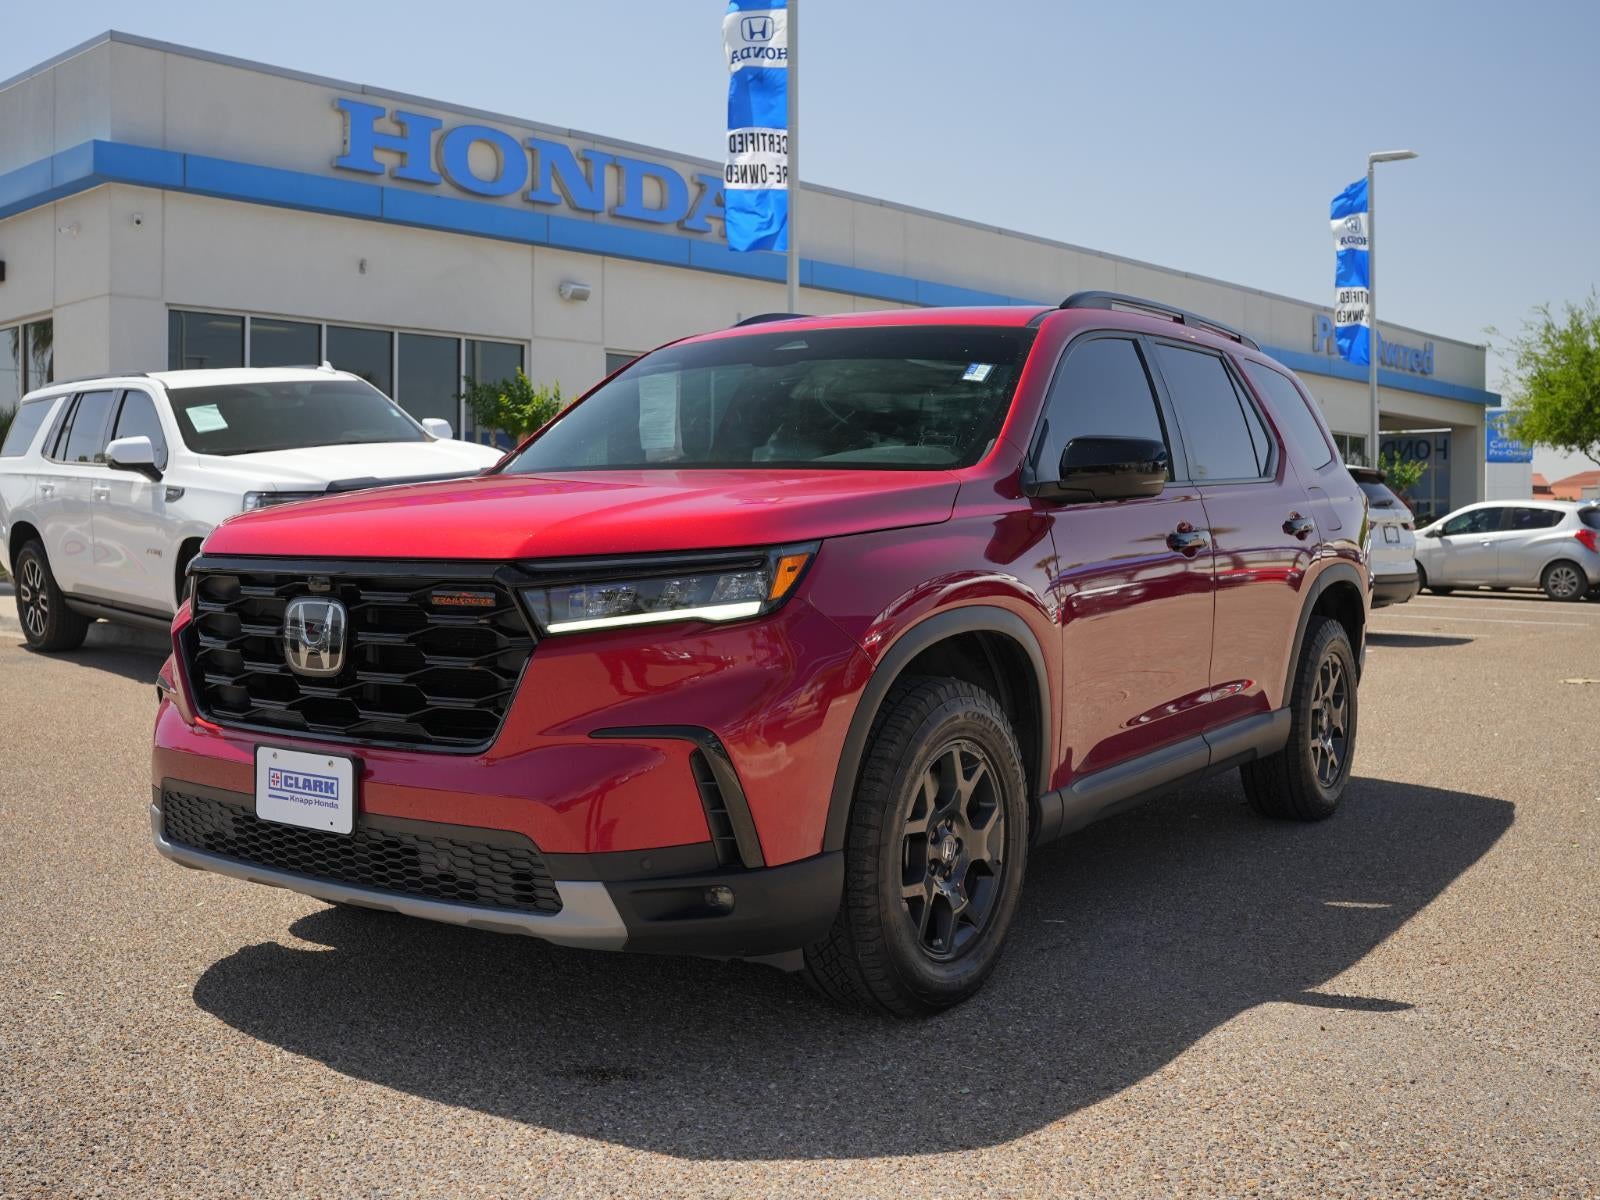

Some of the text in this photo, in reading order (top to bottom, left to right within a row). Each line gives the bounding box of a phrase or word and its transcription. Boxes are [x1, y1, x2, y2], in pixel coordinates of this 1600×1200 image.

[333, 97, 725, 234] HONDA
[283, 774, 335, 795] CLARK
[289, 795, 339, 809] Knapp Honda
